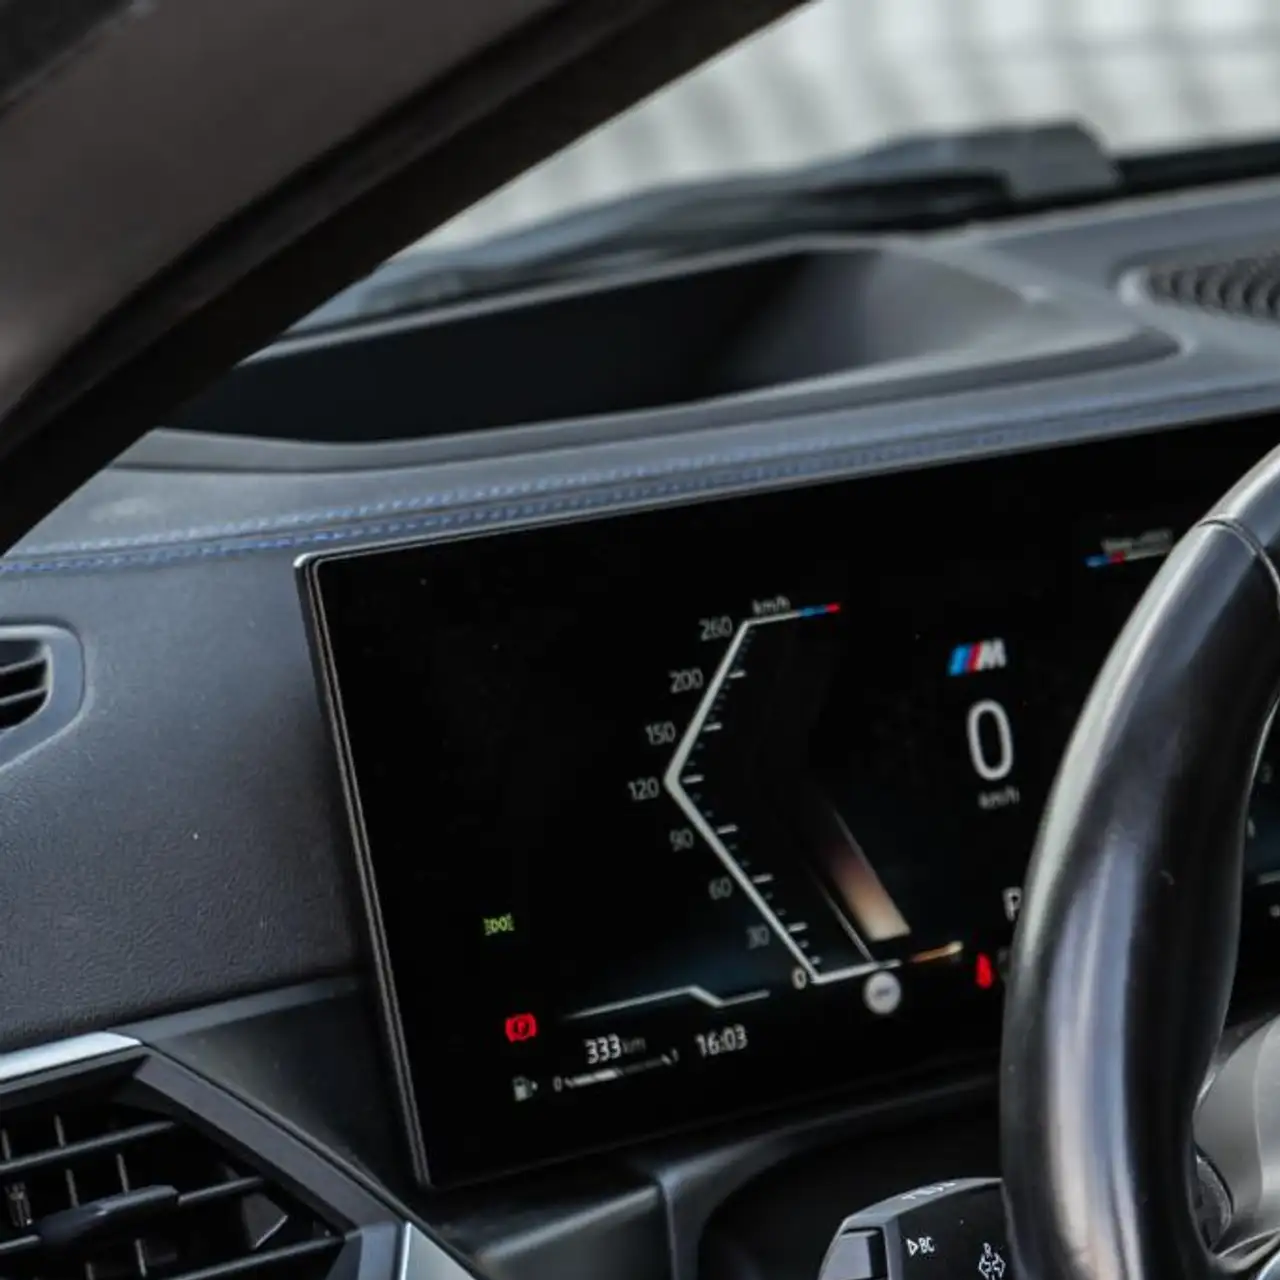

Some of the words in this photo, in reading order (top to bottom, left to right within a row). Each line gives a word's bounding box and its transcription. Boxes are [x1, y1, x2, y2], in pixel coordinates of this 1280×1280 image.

[752, 595, 791, 616] km/h
[698, 615, 733, 641] 260
[668, 668, 704, 693] 200
[645, 721, 676, 745] 150
[966, 698, 1014, 781] 0
[627, 776, 660, 800] 120
[669, 828, 694, 852] 90
[708, 876, 733, 900] 60
[792, 966, 807, 990] 0
[584, 1033, 621, 1064] 333
[695, 1023, 748, 1057] 16:03
[918, 1236, 935, 1254] BC
